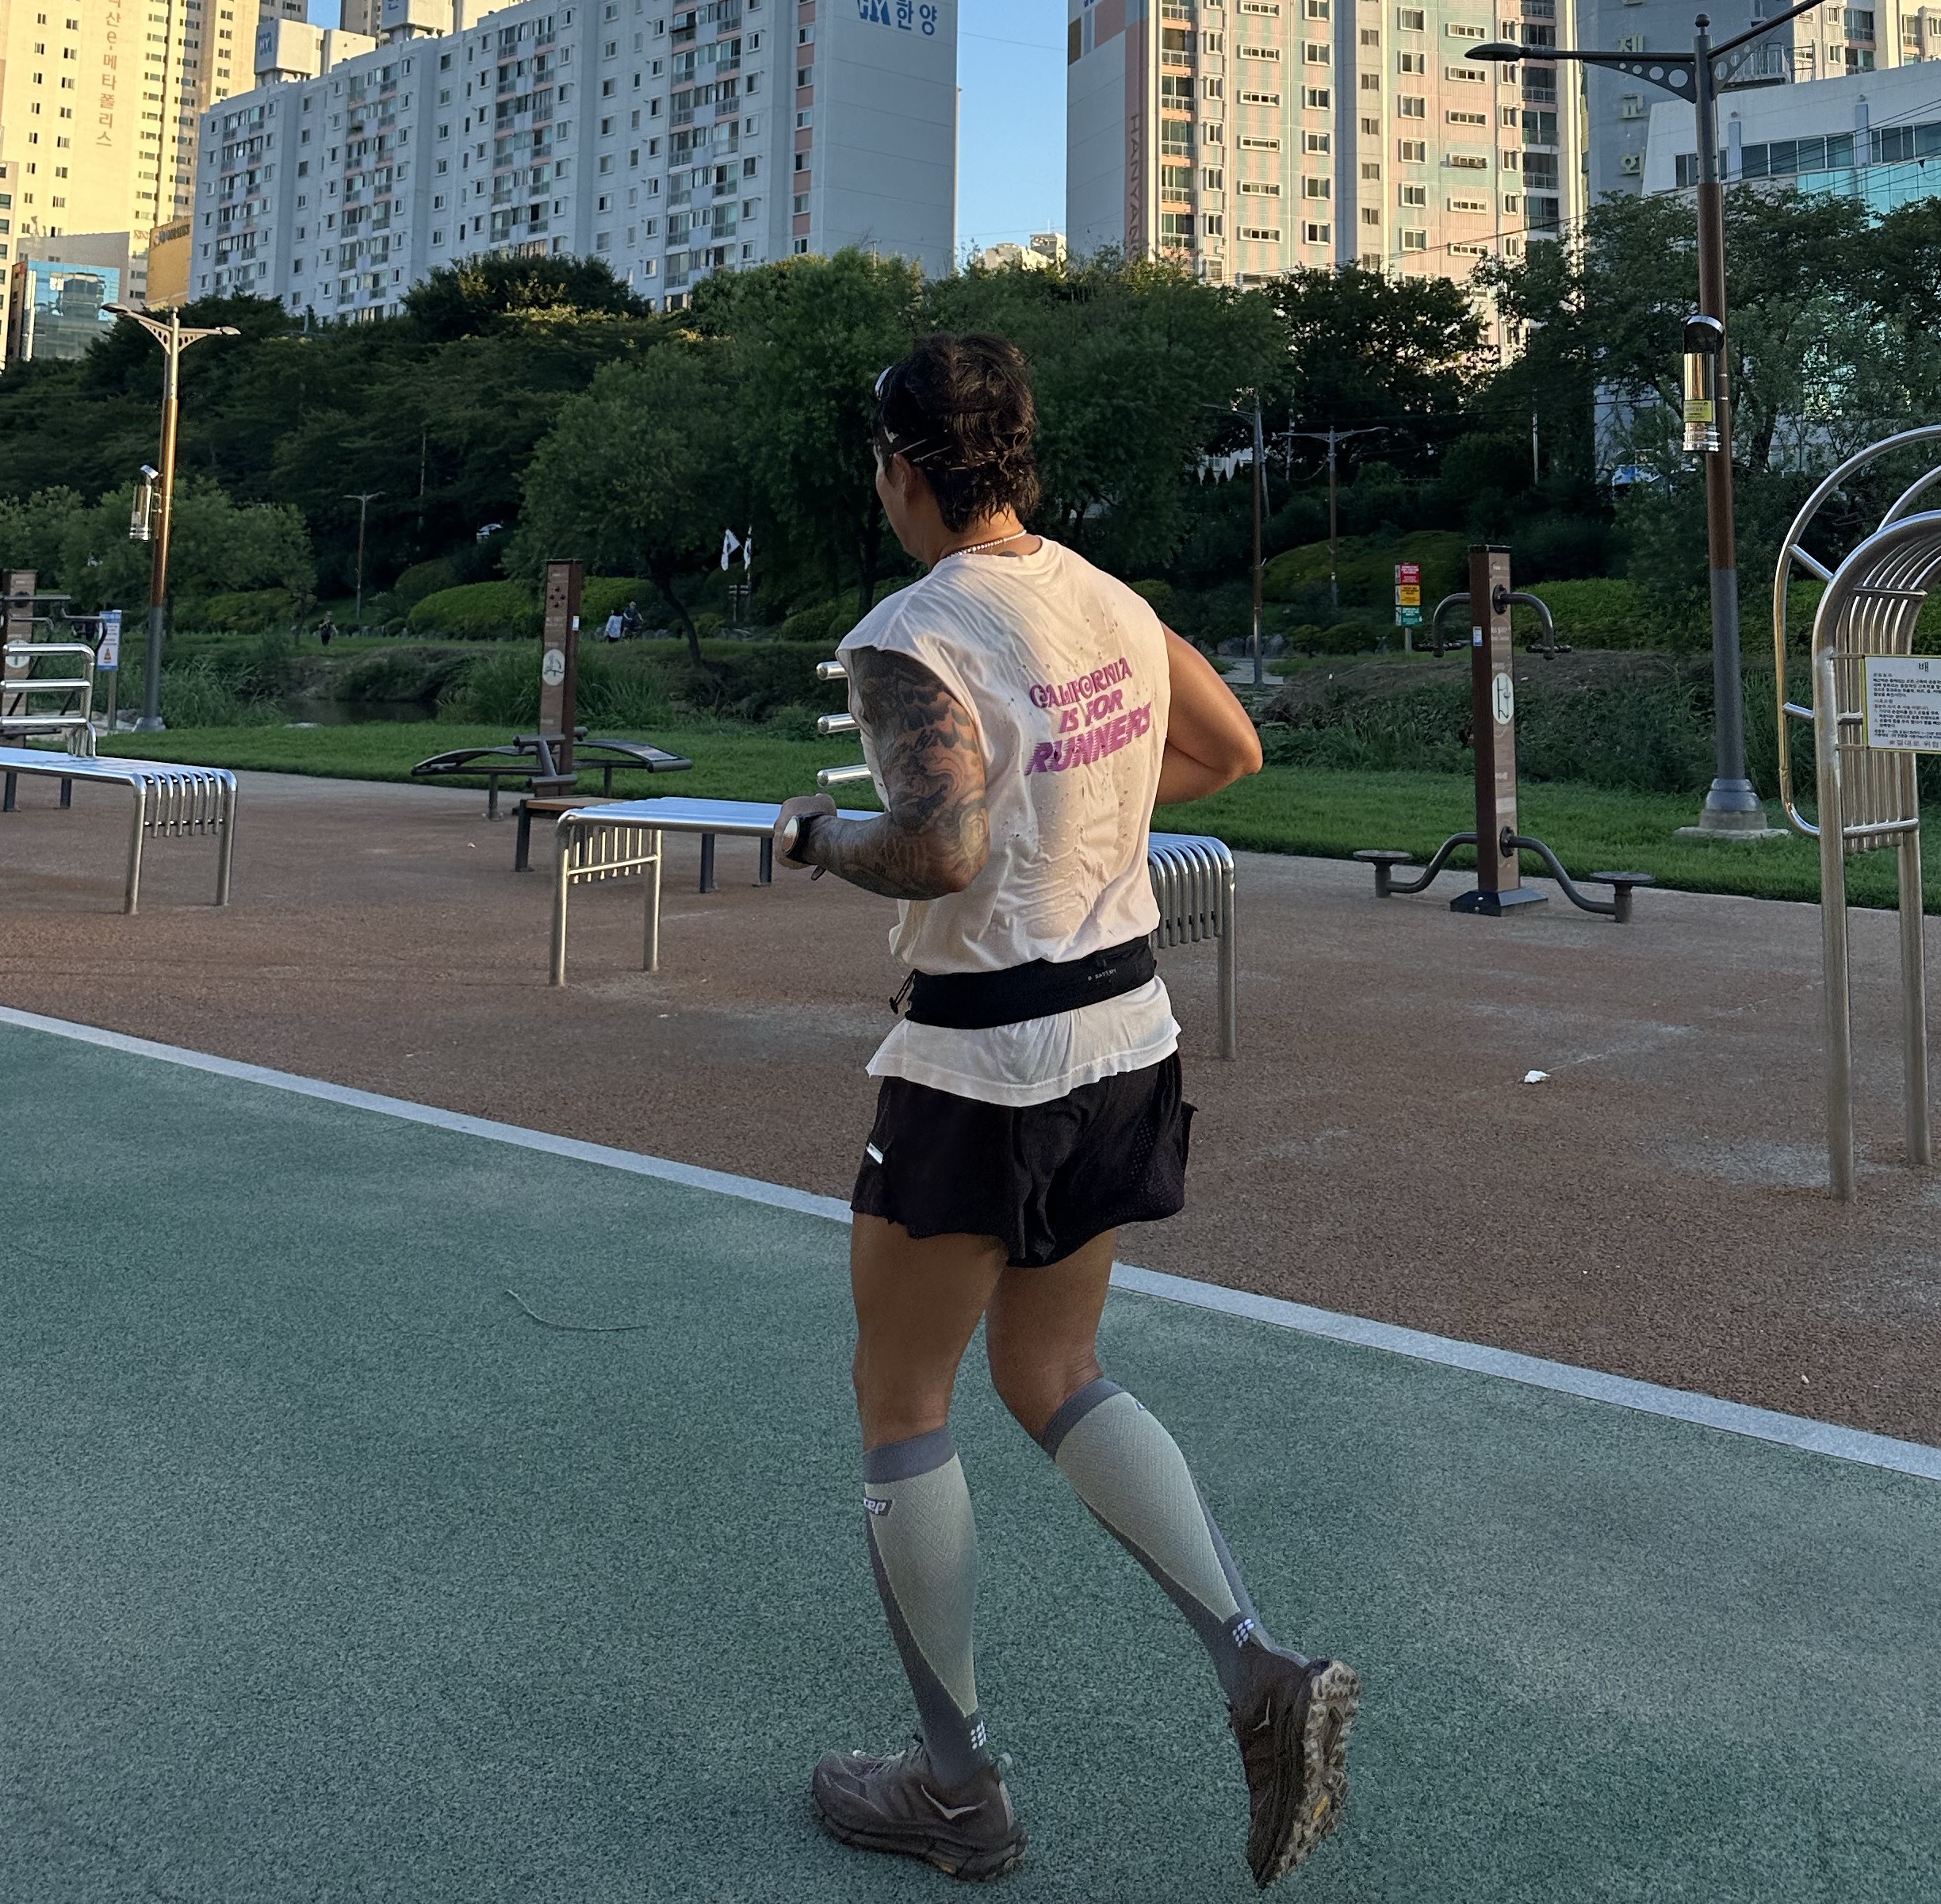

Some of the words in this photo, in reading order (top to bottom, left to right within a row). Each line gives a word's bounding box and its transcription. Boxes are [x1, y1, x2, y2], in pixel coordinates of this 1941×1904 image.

[897, 0, 937, 36] 한양
[96, 0, 121, 147] 산e-메타폴리스
[1030, 657, 1132, 708] CALIFORNIA
[1059, 707, 1079, 734] IS
[1085, 689, 1124, 726] FOR
[1024, 701, 1151, 776] RUNNERS
